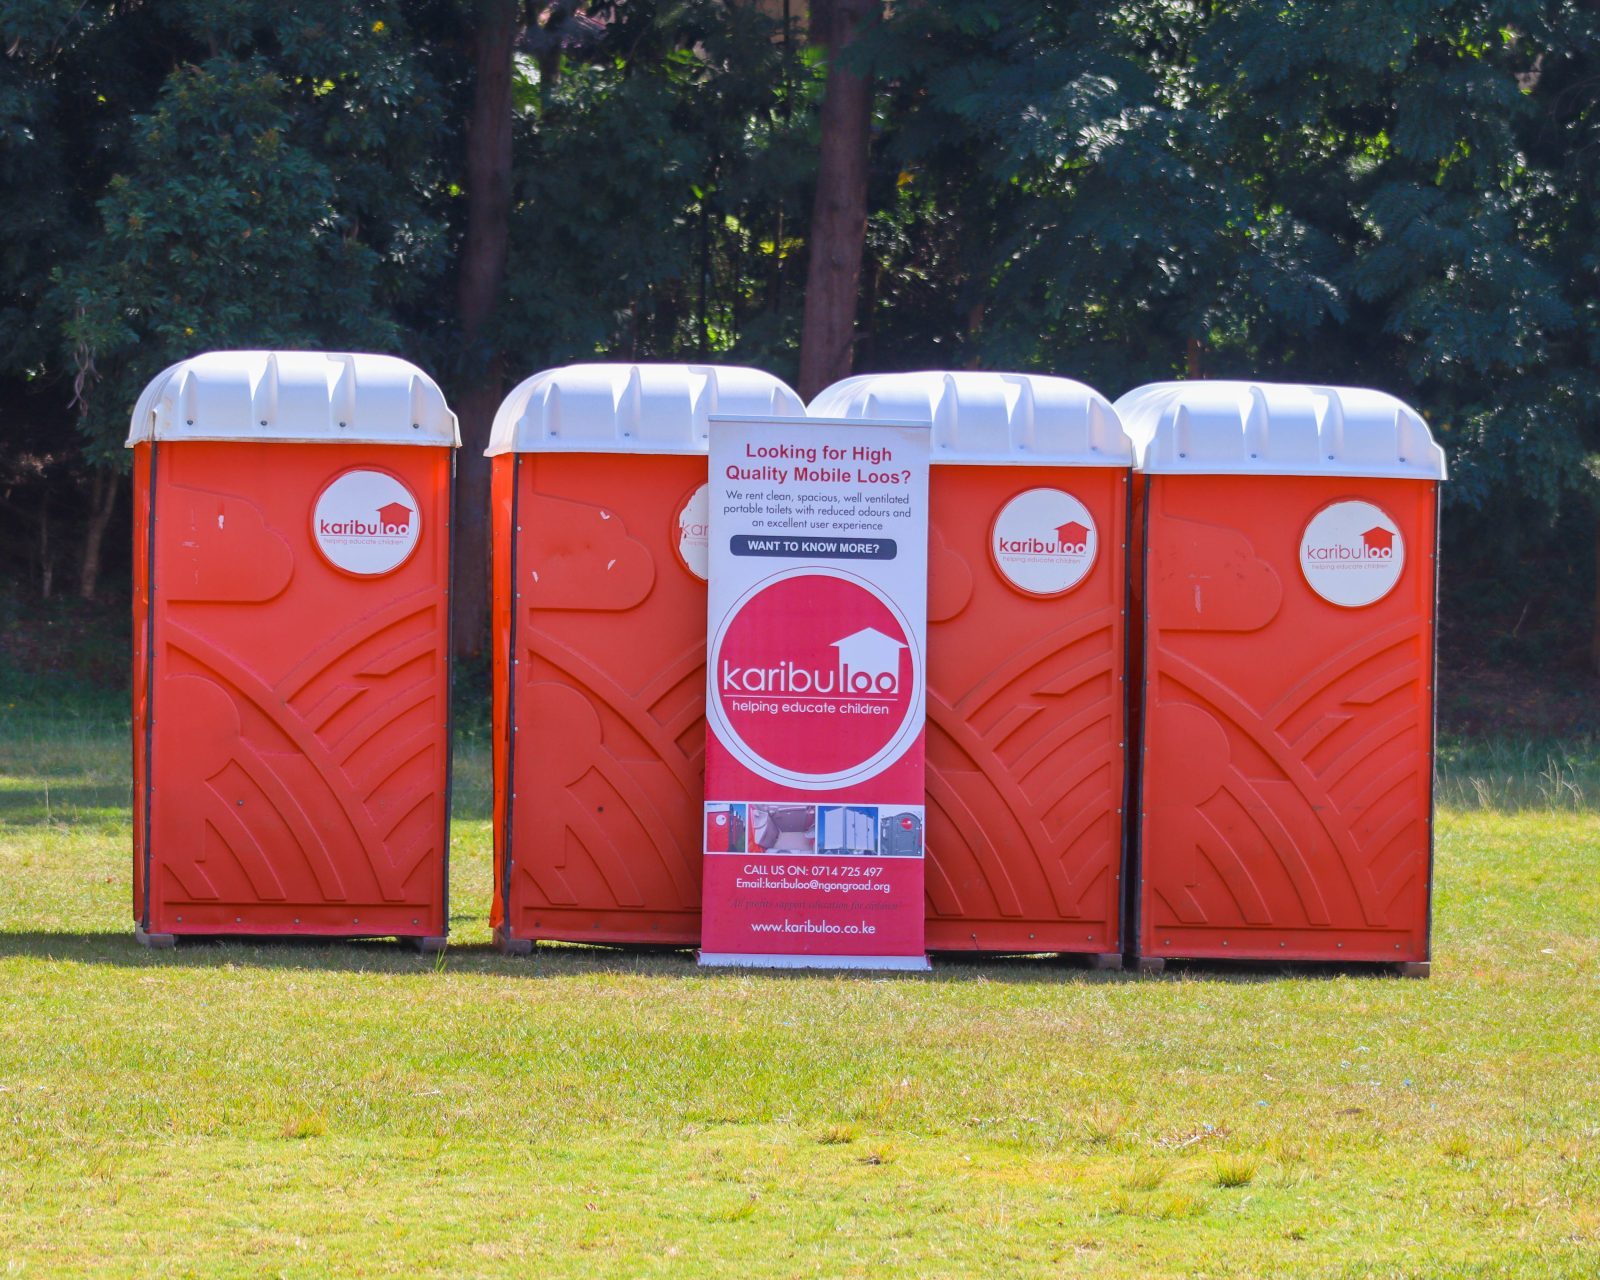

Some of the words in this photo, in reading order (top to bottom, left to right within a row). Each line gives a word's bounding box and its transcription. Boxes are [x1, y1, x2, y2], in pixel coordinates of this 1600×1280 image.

[746, 443, 817, 463] Looking
[822, 445, 847, 460] for
[852, 446, 892, 465] High
[726, 465, 788, 484] Quality
[794, 467, 851, 483] Mobile
[857, 469, 911, 484] Loos?
[726, 490, 742, 500] We
[745, 491, 763, 500] rent
[766, 490, 794, 502] clean,
[797, 493, 840, 504] spacious,
[843, 493, 862, 503] well
[865, 494, 909, 505] ventilated
[723, 504, 763, 515] portable
[766, 504, 792, 515] toilets
[795, 505, 815, 515] with
[817, 506, 855, 516] reduced
[858, 507, 890, 517] odours
[893, 507, 911, 518] and
[320, 519, 409, 535] karibuloo
[752, 519, 764, 527] an
[767, 518, 807, 528] excellent
[810, 520, 829, 529] user
[832, 521, 883, 531] experience
[748, 541, 780, 551] WANT
[783, 541, 798, 551] TO
[801, 541, 838, 552] KNOW
[839, 542, 880, 553] MORE?
[999, 537, 1087, 554] karibuloo
[1307, 544, 1393, 560] karibuloo
[723, 660, 899, 694] karibuloo
[732, 700, 778, 714] helping
[782, 701, 836, 713] educate
[839, 703, 889, 715] children
[744, 864, 768, 875] CALL
[771, 865, 785, 876] US
[787, 866, 809, 876] ON:
[811, 866, 838, 876] 0714
[840, 867, 860, 877] 725
[863, 867, 883, 877] 497
[736, 878, 891, 893] Email:karibuloo@ngongroad.org
[751, 919, 876, 934] www.karibuloo.co.ke
